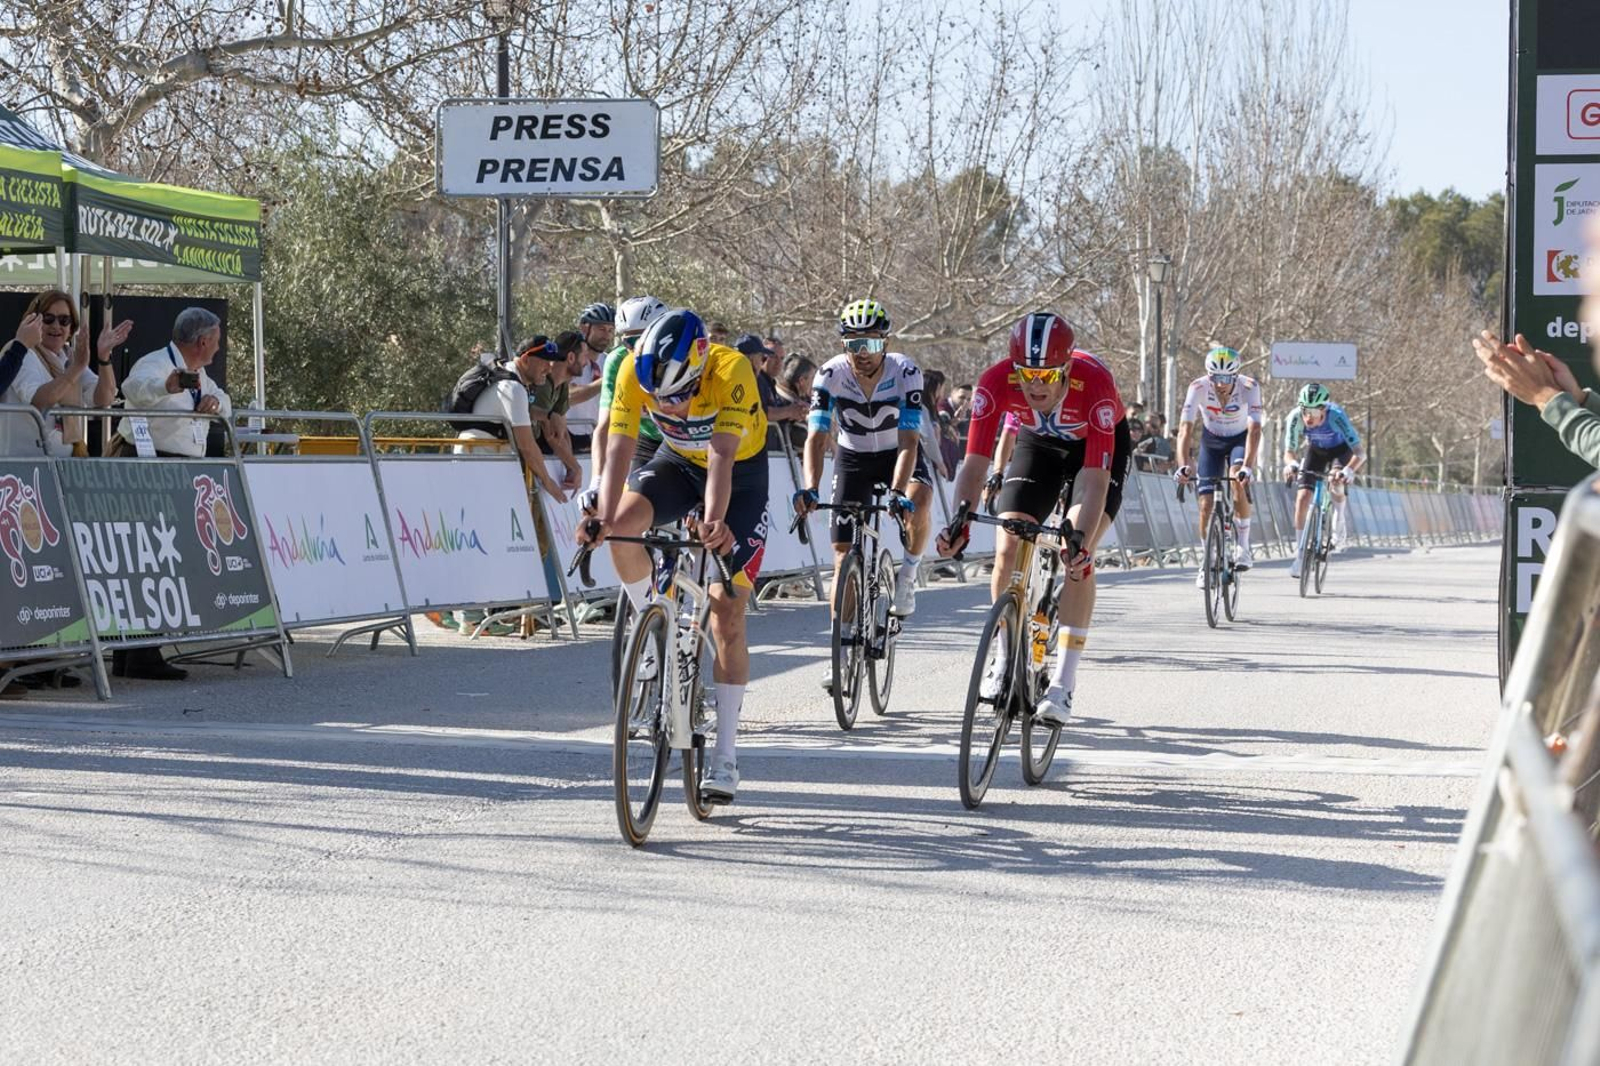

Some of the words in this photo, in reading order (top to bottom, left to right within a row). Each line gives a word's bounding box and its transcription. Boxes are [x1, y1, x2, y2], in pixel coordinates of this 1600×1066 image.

[489, 113, 612, 141] PRESS
[475, 156, 625, 184] PRENSA
[8, 177, 61, 209] CICLISTA
[78, 204, 116, 239] RUTA
[114, 212, 142, 242] DEL
[213, 221, 260, 249] CICLISTA
[182, 246, 245, 276] ANDALUCÍA
[687, 423, 714, 435] BO
[62, 462, 125, 489] VUELTA
[125, 463, 192, 490] CICLISTA
[69, 494, 81, 522] A
[83, 489, 180, 522] ANDALUCÍA
[72, 521, 160, 575] RUTA
[263, 511, 346, 570] Andalucía
[396, 505, 489, 560] Andalucía
[86, 578, 146, 632] DEL
[141, 576, 202, 630] SOL
